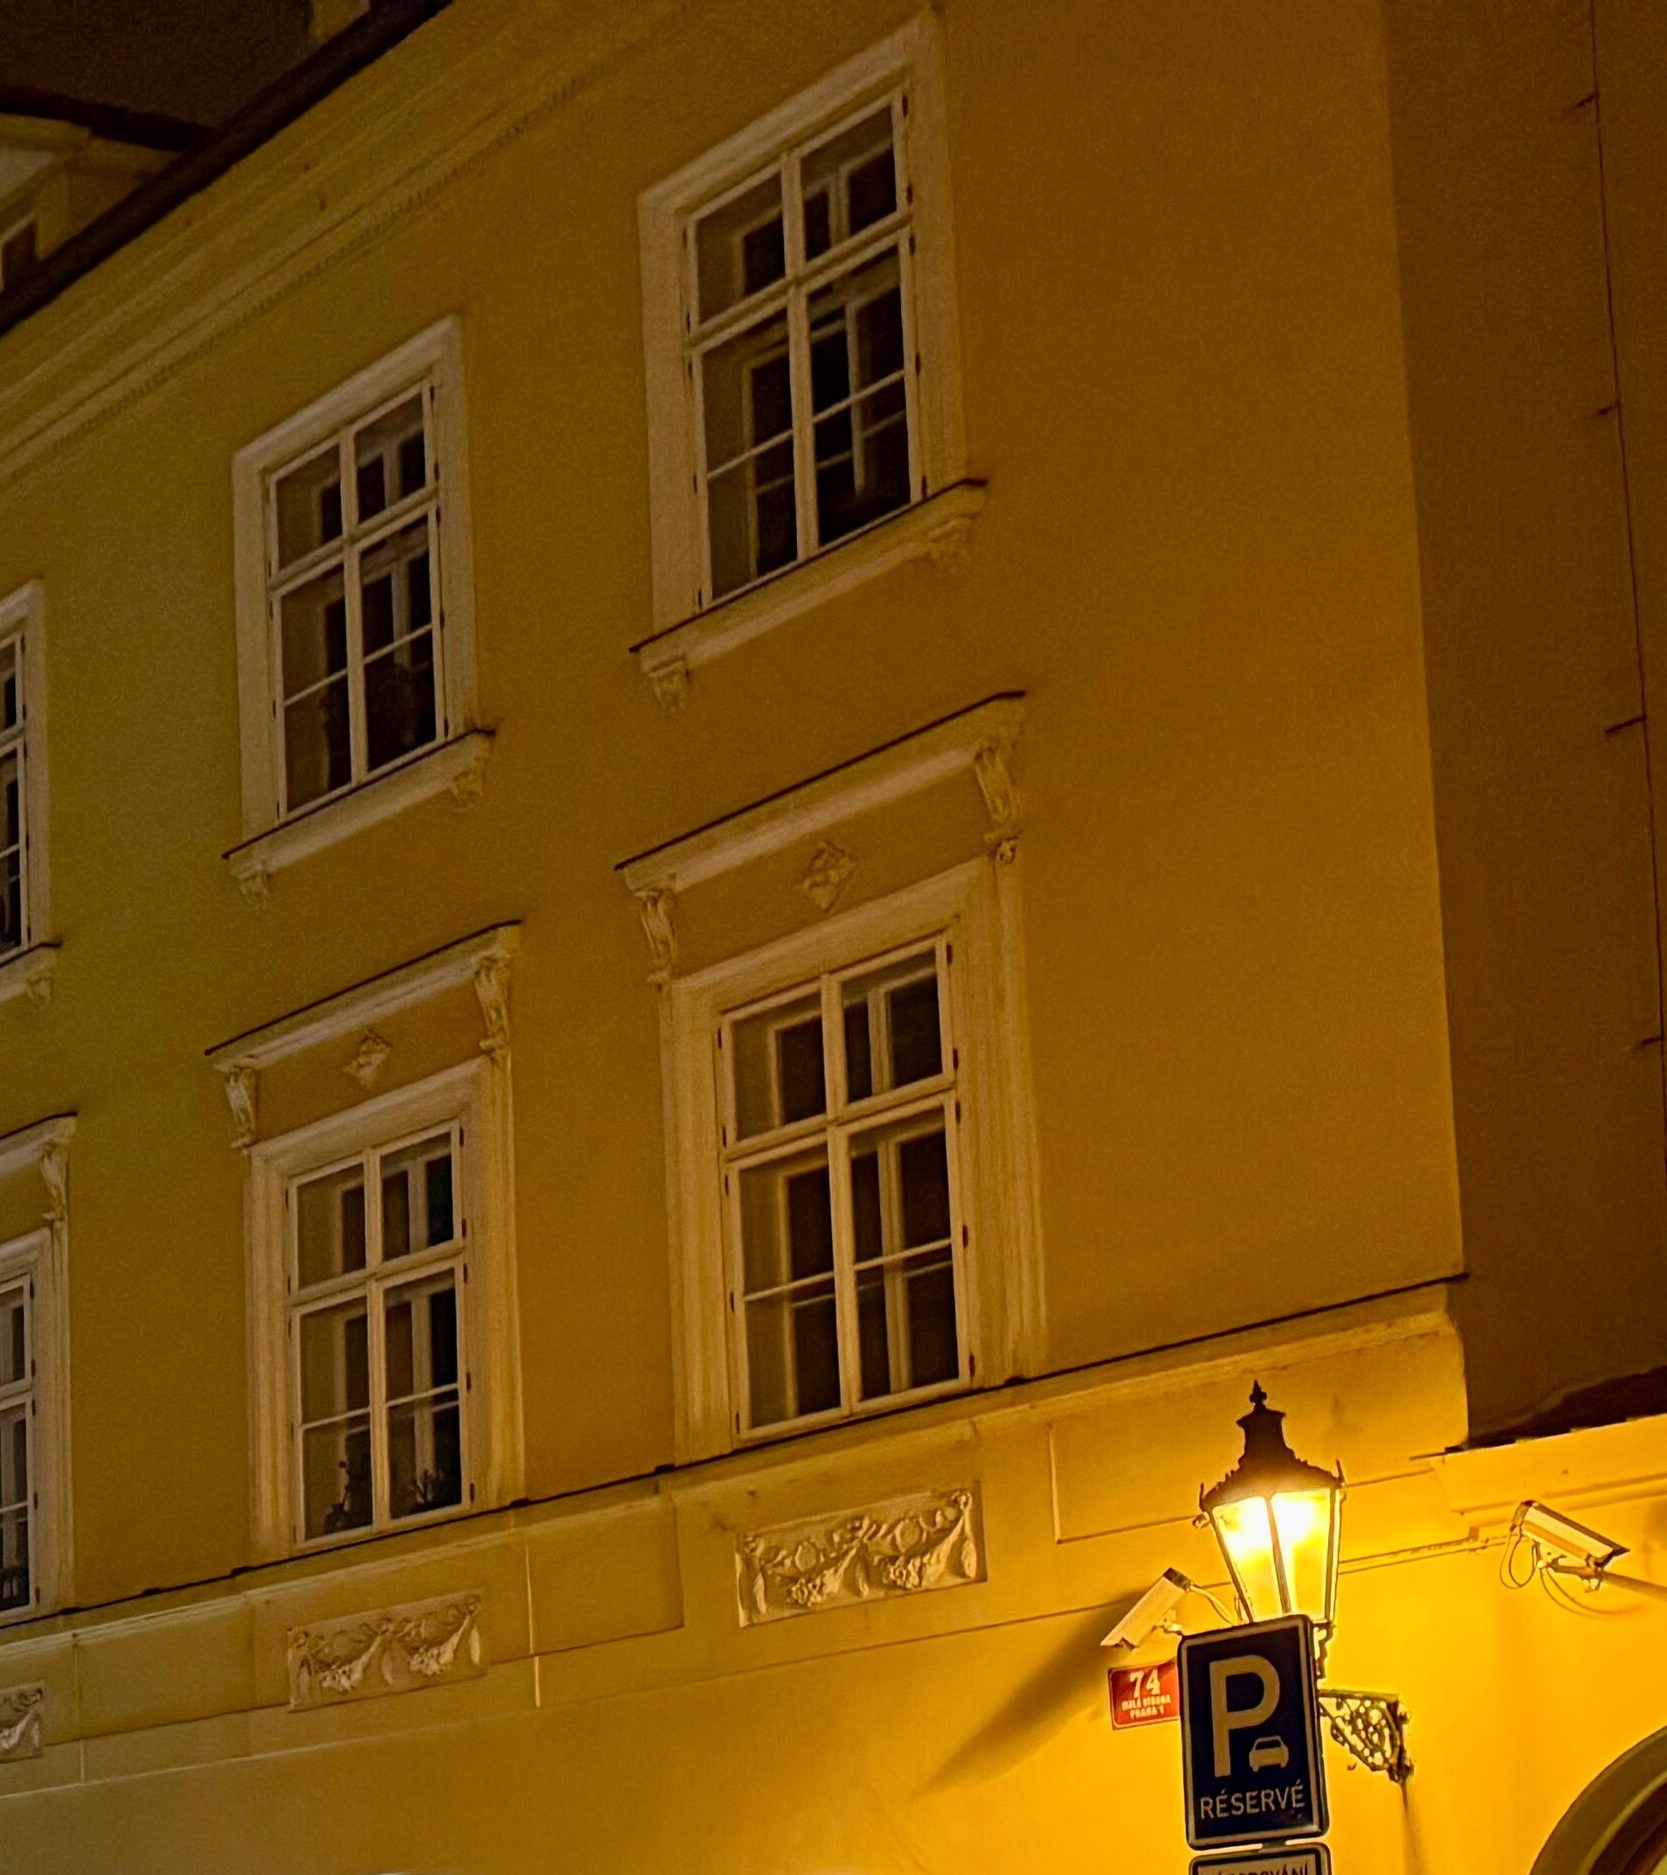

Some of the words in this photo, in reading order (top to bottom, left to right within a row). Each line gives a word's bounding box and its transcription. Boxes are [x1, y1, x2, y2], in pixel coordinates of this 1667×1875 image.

[1129, 1668, 1161, 1698] 74
[1209, 1654, 1280, 1777] P
[1200, 1779, 1306, 1820] RÉSERVÉ
